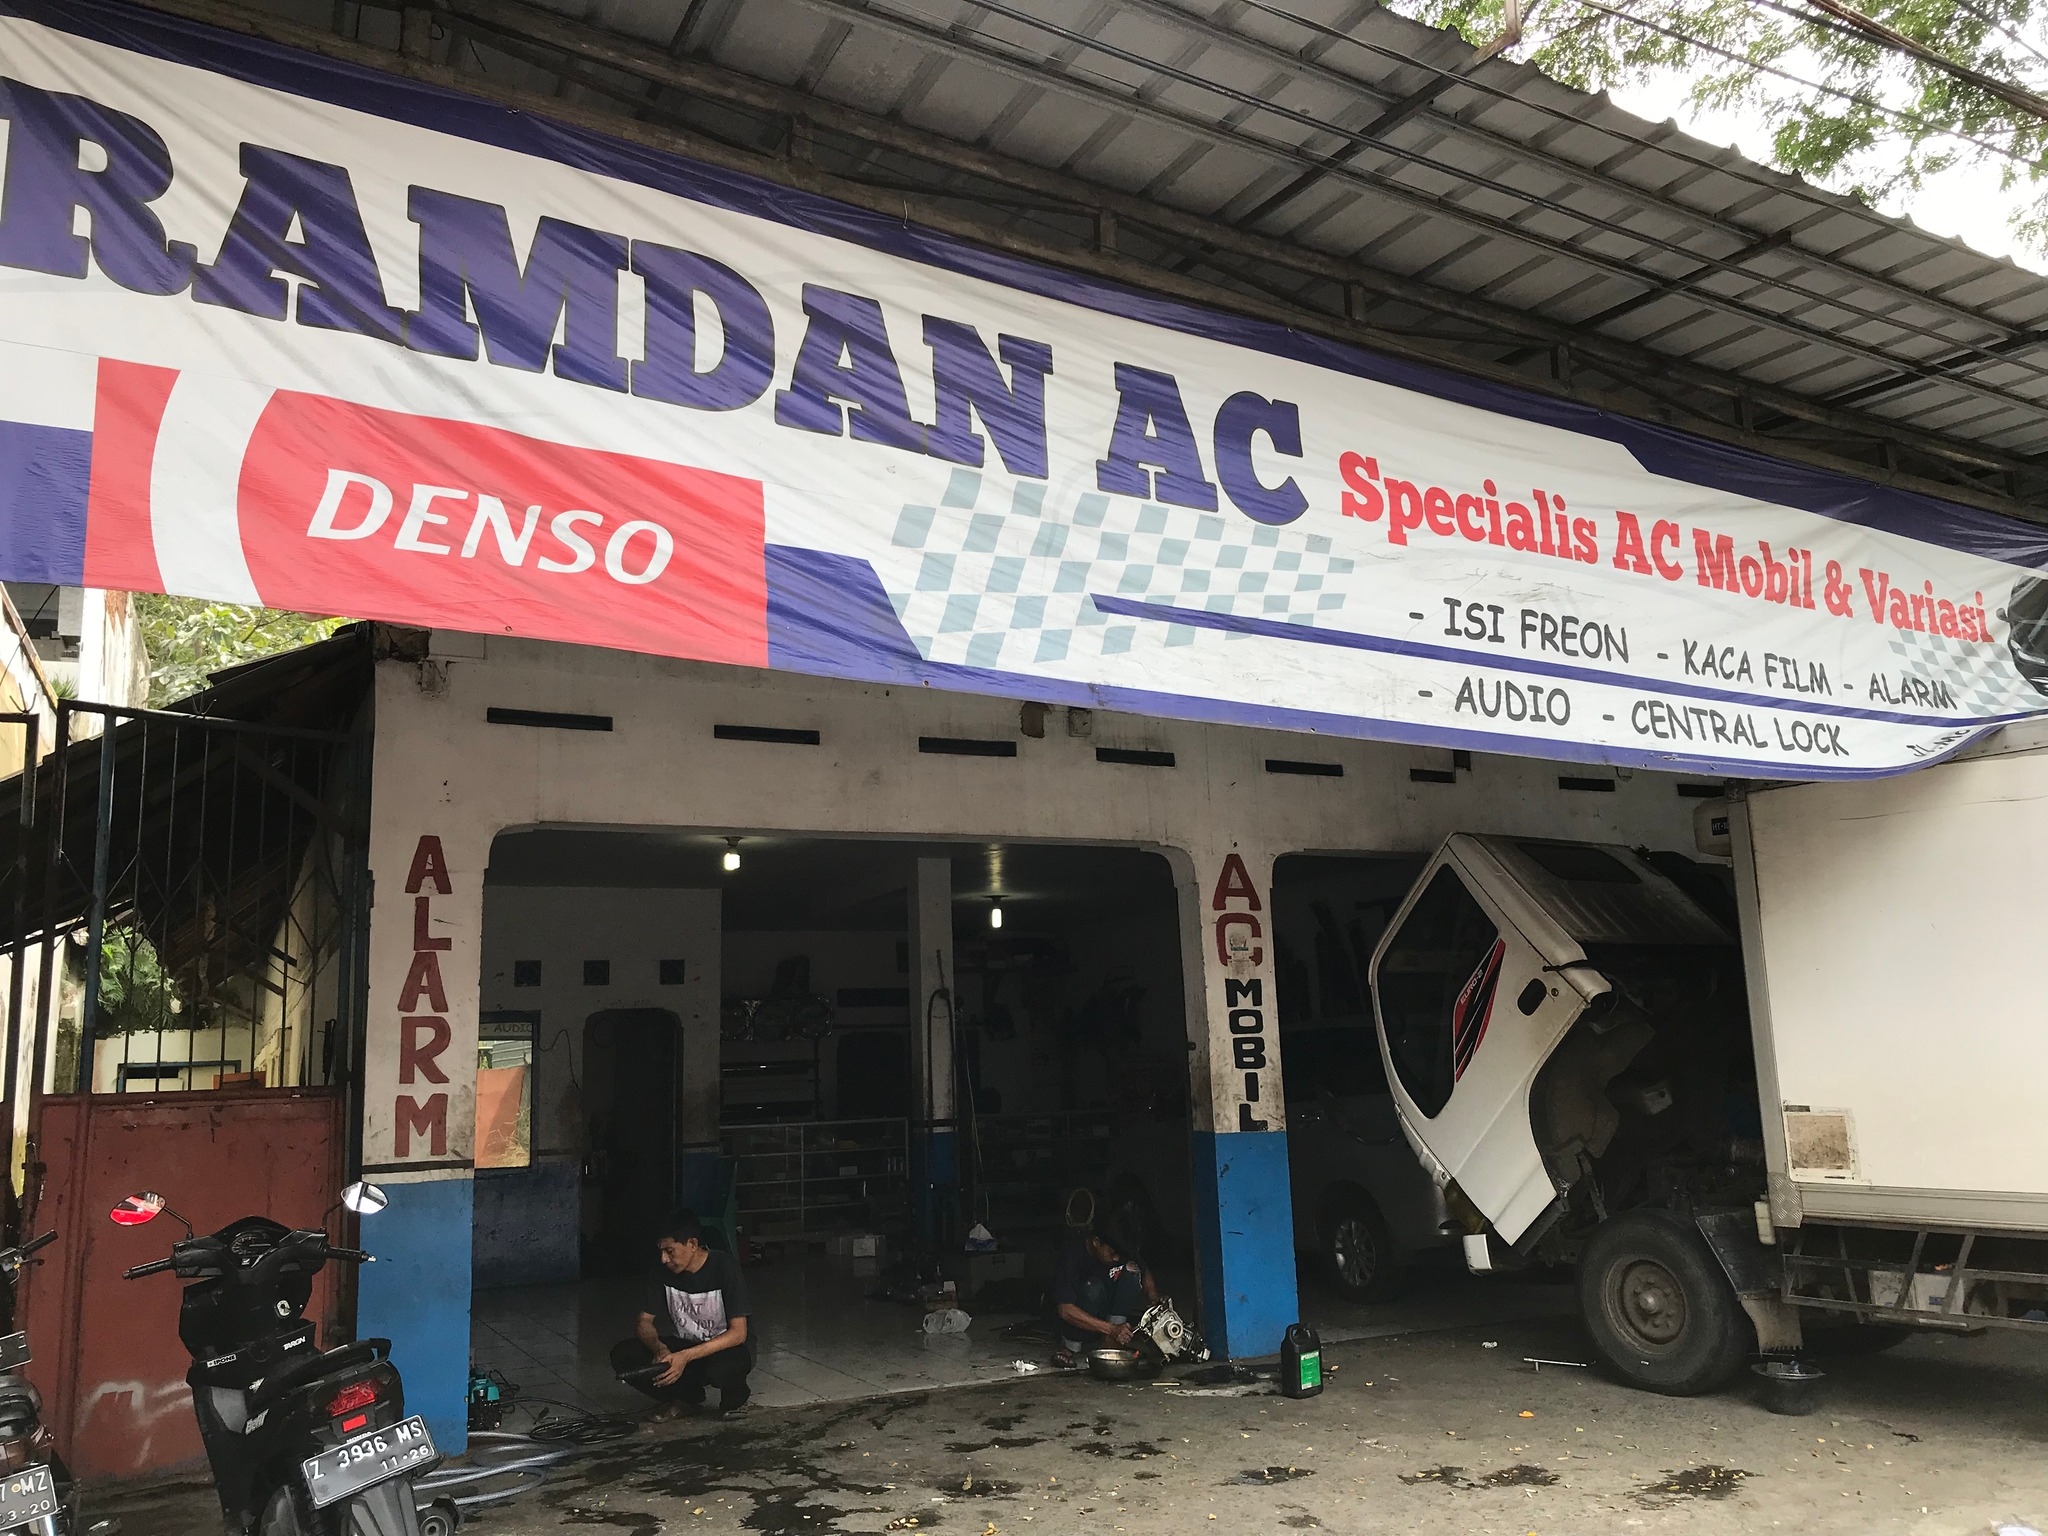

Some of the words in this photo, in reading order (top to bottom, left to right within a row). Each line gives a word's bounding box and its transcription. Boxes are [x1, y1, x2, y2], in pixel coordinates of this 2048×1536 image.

[0, 75, 1053, 479] RAMDAN
[1096, 361, 1309, 526] AC
[306, 468, 674, 585] DENSO
[1338, 450, 1599, 565] Specialis
[1612, 510, 1685, 581] AC
[1692, 527, 1816, 610] Mobil
[1824, 560, 1853, 618] &
[1859, 567, 1994, 643] Variasi
[1443, 597, 1505, 643] ISI
[1520, 609, 1629, 663] FREON
[1682, 638, 1754, 684] KACA
[1764, 652, 1832, 696] FILM
[1868, 672, 1958, 710] ALARM
[1454, 676, 1570, 726] AUDIO
[1631, 700, 1769, 748] CENTRAL
[1773, 717, 1850, 757] LOCK
[1211, 853, 1262, 967] AC
[394, 835, 453, 1157] ALARM
[1225, 978, 1268, 1132] MOBIL
[20, 1471, 48, 1496] MZ
[309, 1460, 325, 1480] Z
[338, 1436, 388, 1469] 3936
[395, 1421, 422, 1443] MS
